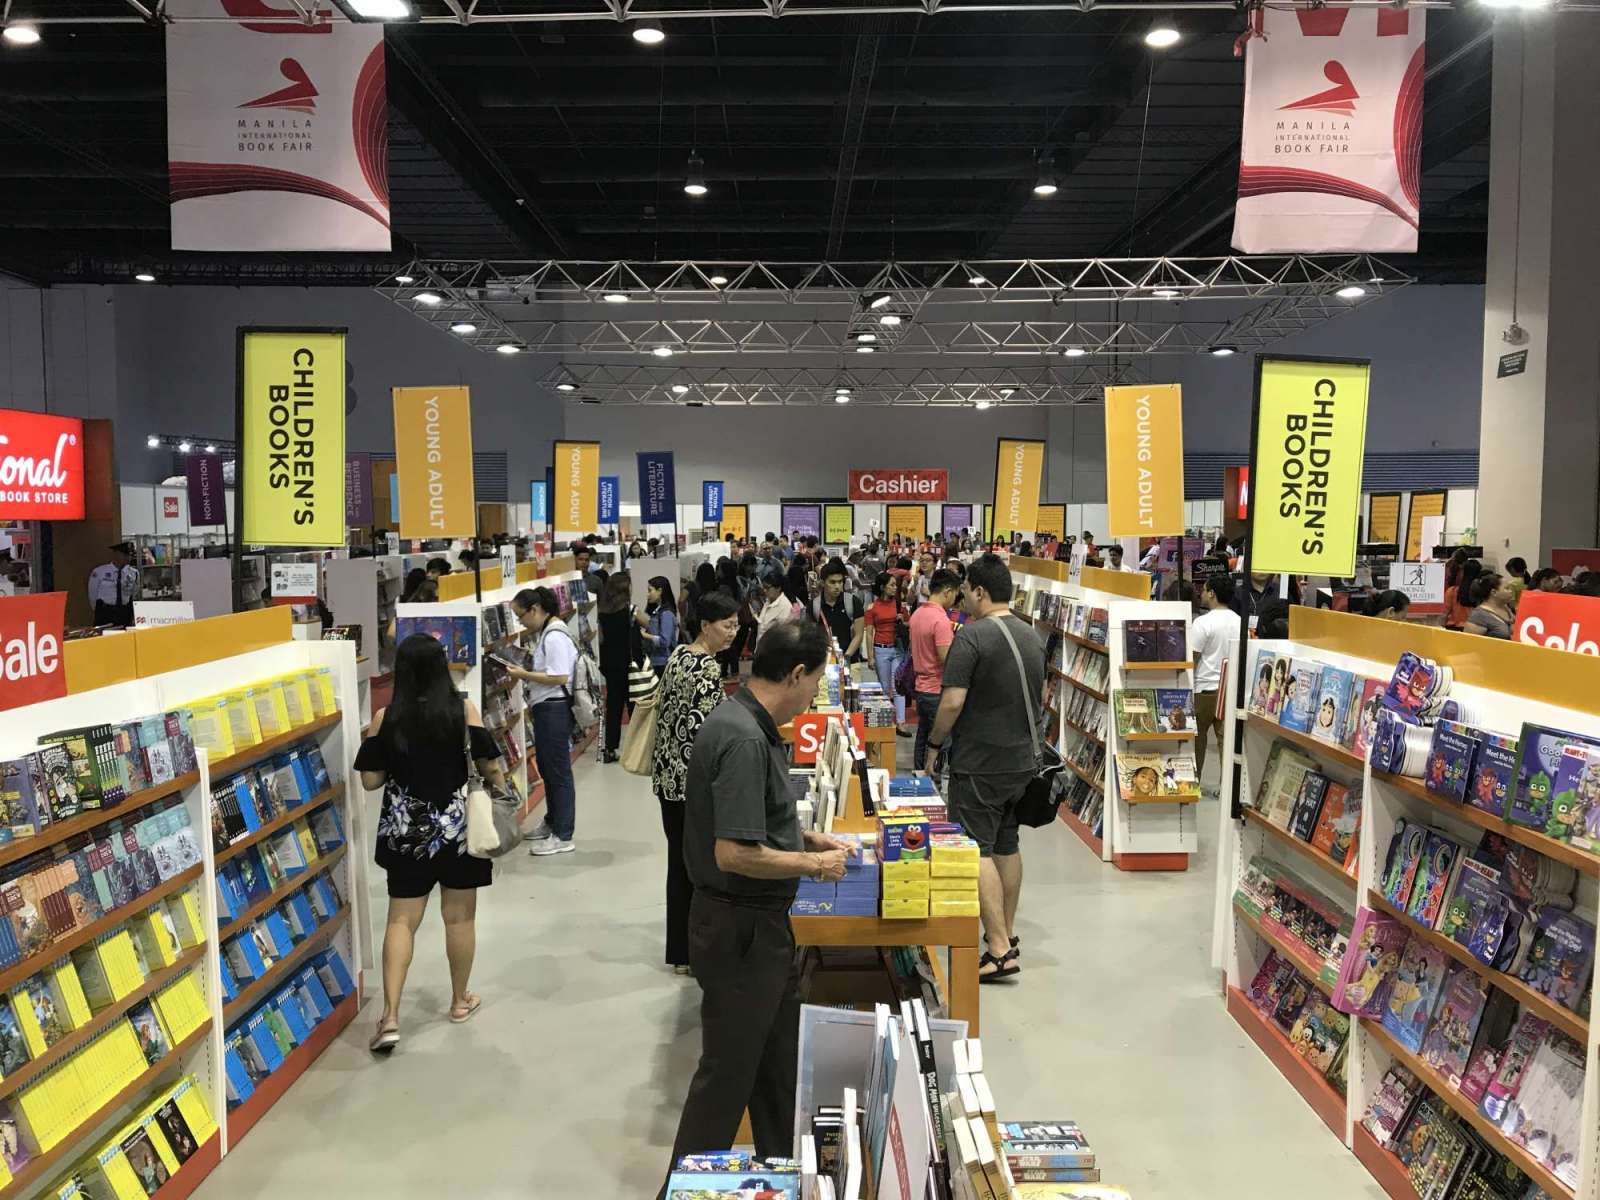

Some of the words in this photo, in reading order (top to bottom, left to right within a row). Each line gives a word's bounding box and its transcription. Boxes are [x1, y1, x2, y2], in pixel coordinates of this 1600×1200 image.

[238, 120, 312, 128] MANILA
[1276, 121, 1350, 130] MANILA
[238, 142, 275, 151] BOOK
[282, 142, 312, 151] FAIR
[1274, 143, 1311, 153] BOOK
[1320, 143, 1349, 153] FAIR
[269, 385, 290, 489] BOOKS
[293, 348, 314, 525] CHILDREN'S
[424, 396, 440, 463] YOUNG
[1135, 394, 1152, 461] YOUNG
[0, 433, 68, 487] onal
[570, 447, 581, 487] YOUNG
[1013, 444, 1024, 485] YOUNG
[1279, 414, 1308, 518] BOOKS
[1302, 378, 1336, 555] CHILDREN'S
[0, 491, 30, 502] BOOK
[34, 492, 68, 503] STORE
[199, 459, 212, 520] NON-FICTION
[427, 470, 444, 528] ADULT
[648, 461, 658, 516] LITERATURE
[656, 463, 665, 499] FICTION
[859, 474, 939, 494] Cashier
[1137, 468, 1153, 528] ADULT
[571, 490, 580, 527] ADULT
[1009, 488, 1020, 526] ADULT
[0, 621, 58, 680] ale
[927, 1072, 936, 1088] DOG
[929, 1088, 939, 1103] MAN
